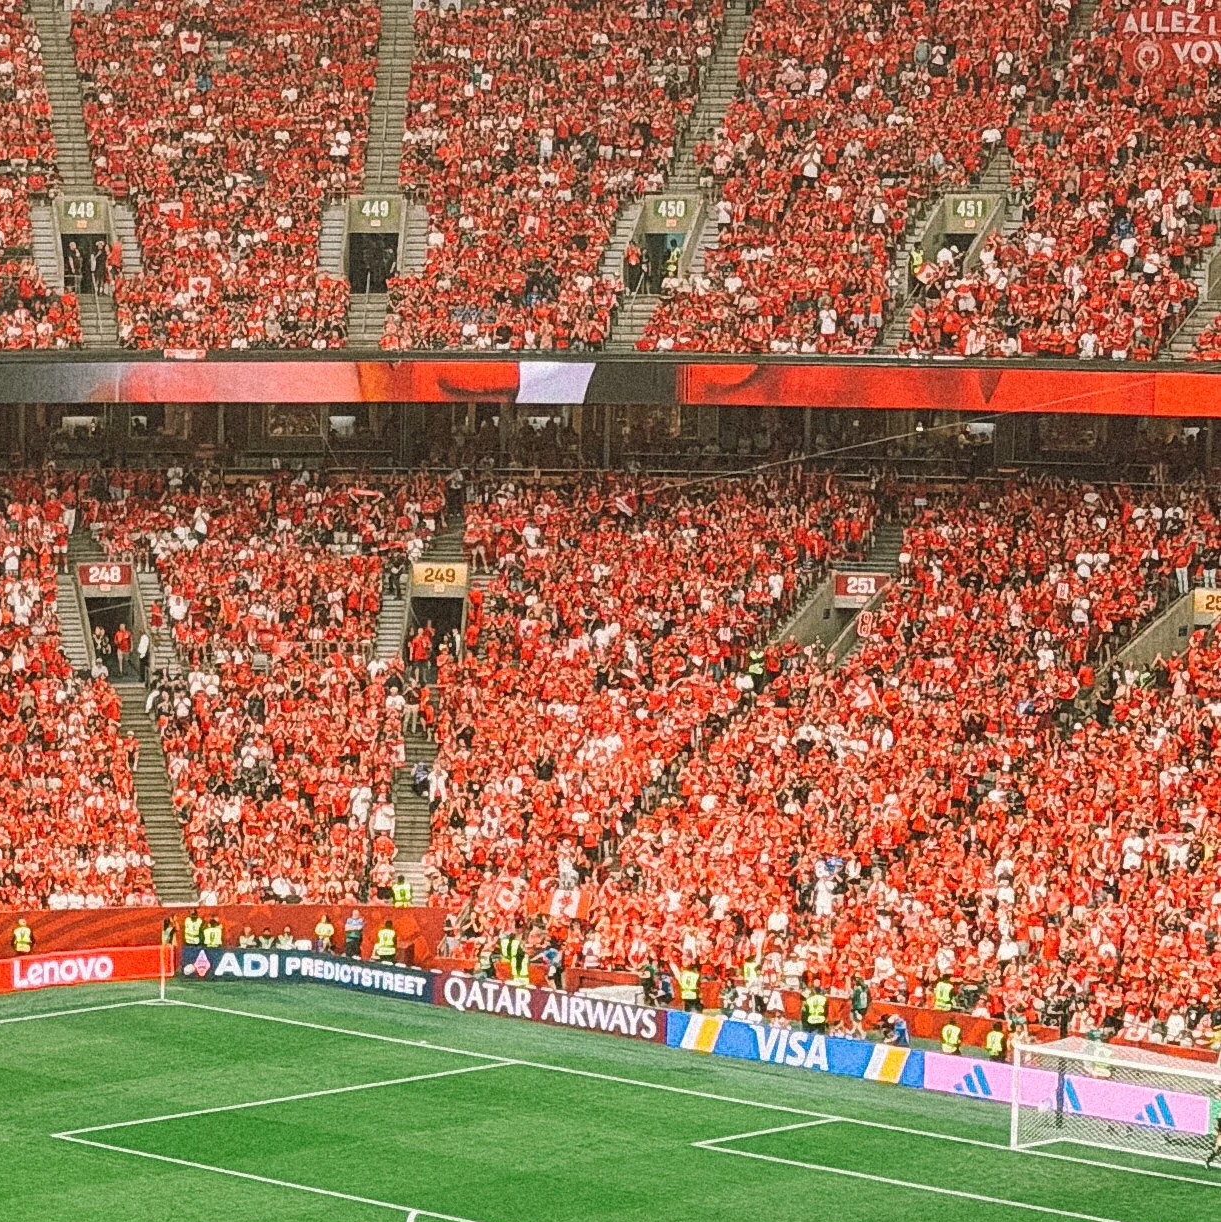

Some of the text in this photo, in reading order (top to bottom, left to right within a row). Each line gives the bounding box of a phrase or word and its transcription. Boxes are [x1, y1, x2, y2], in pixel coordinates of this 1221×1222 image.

[1122, 10, 1202, 34] ALLEZ
[68, 202, 95, 218] 448
[361, 201, 389, 217] 449
[658, 201, 685, 217] 450
[957, 201, 983, 217] 451
[88, 566, 121, 583] 248
[424, 567, 456, 583] 249
[846, 576, 876, 594] 251
[13, 956, 113, 988] Lenovo
[214, 952, 427, 996] ADI PREDICTSTREET
[443, 977, 657, 1039] QATAR AIRWAYS
[749, 1024, 829, 1071] VISA
